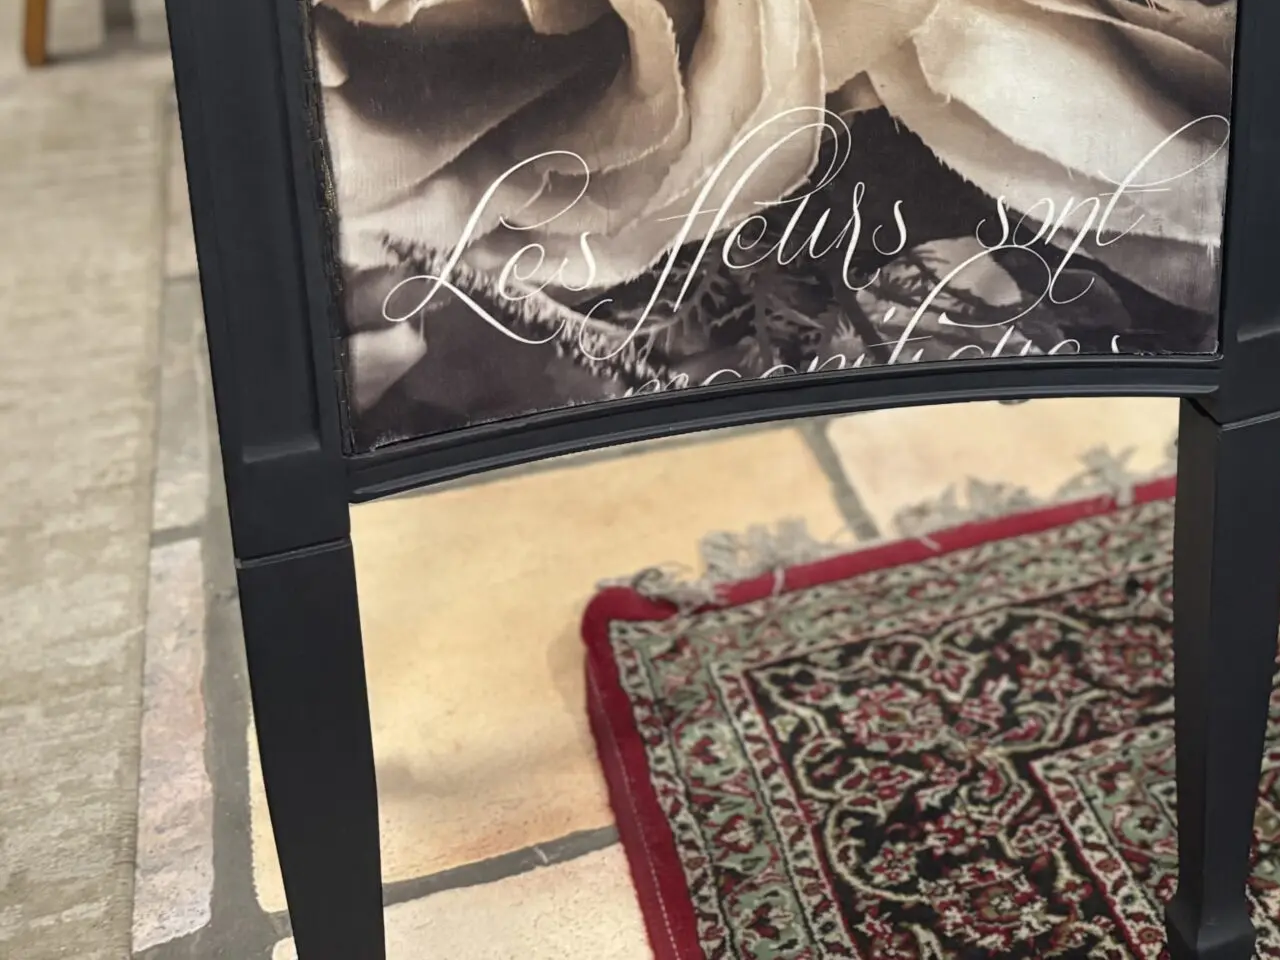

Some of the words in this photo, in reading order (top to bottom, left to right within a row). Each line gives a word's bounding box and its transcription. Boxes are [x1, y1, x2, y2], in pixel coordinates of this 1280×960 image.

[382, 150, 598, 344] Les
[579, 106, 908, 361] fleurs
[975, 114, 1231, 305] sont
